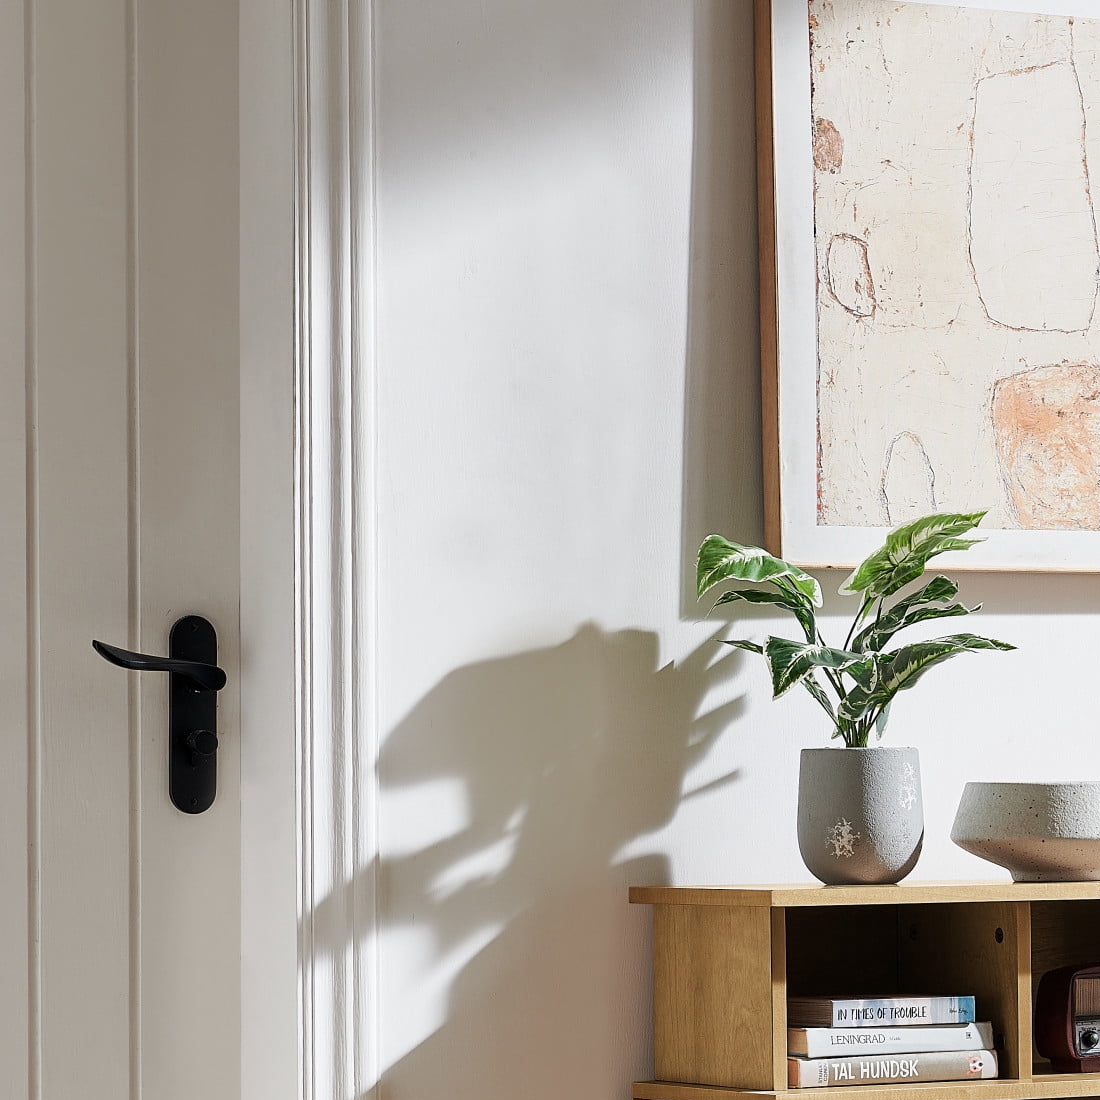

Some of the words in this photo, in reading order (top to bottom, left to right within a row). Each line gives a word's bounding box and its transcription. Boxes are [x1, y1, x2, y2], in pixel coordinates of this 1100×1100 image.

[837, 1008, 847, 1021] IN
[851, 1007, 874, 1020] TIMES
[877, 1007, 888, 1020] OF
[889, 1006, 927, 1020] TROUBLE
[830, 1033, 886, 1046] LENINGRAD
[831, 1062, 856, 1081] TAL
[860, 1059, 919, 1079] HUNDSK
